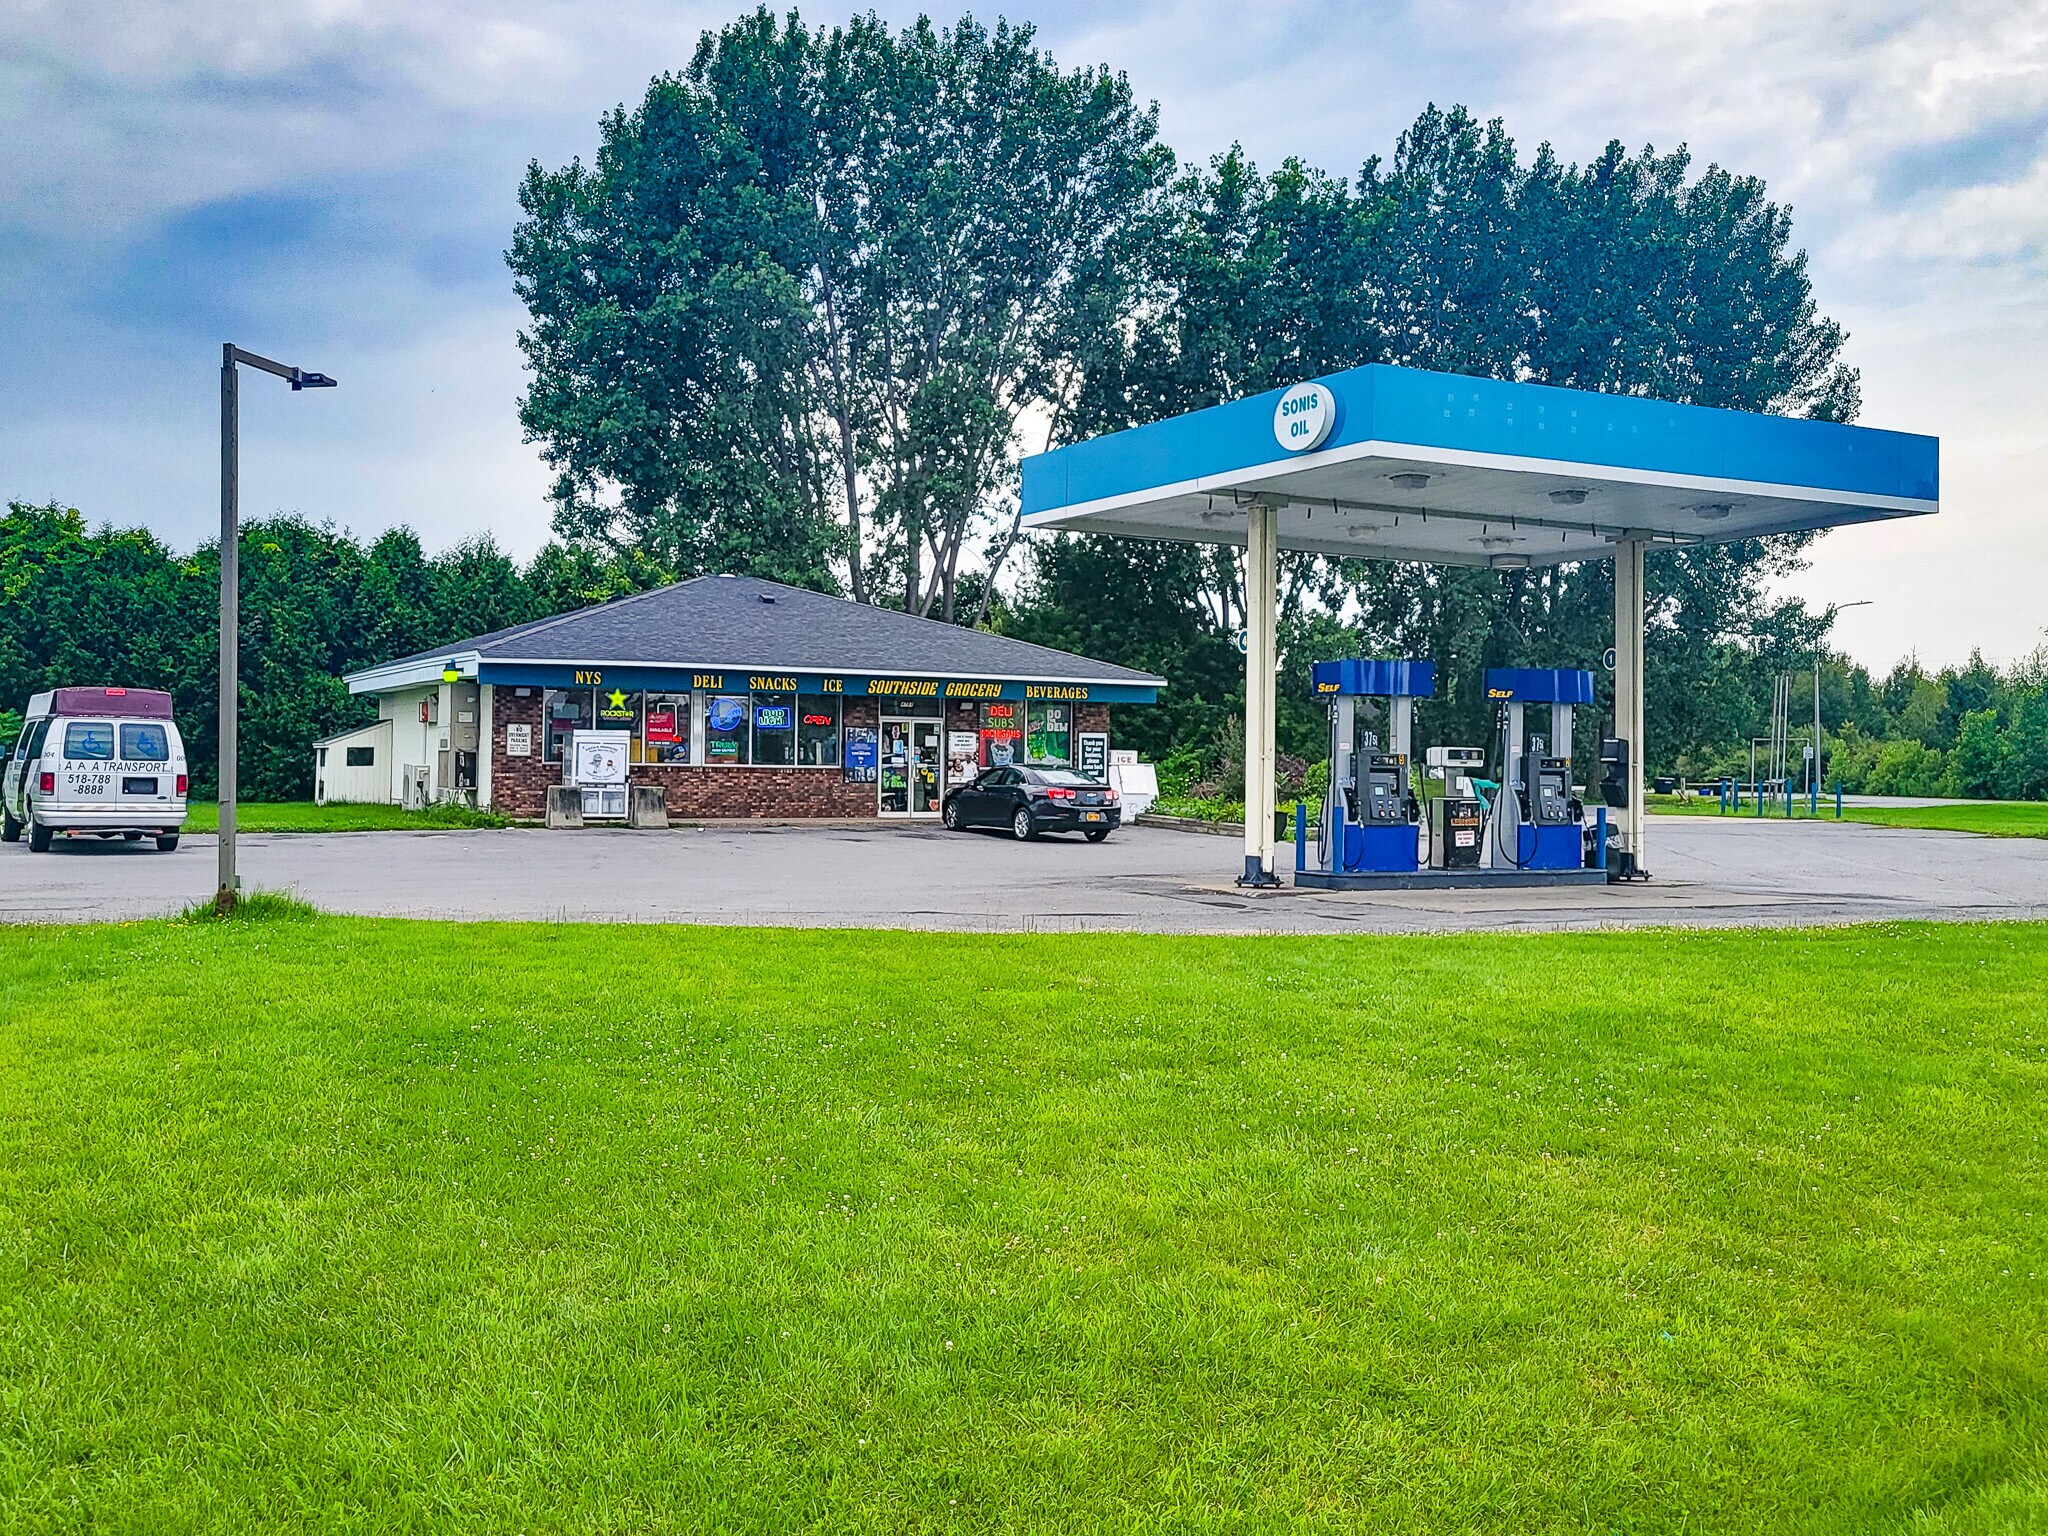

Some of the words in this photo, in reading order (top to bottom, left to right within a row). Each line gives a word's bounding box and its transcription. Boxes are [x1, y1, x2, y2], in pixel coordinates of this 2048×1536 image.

[1282, 393, 1318, 416] SONIS
[1290, 420, 1309, 437] OIL
[575, 671, 602, 685] NYS
[693, 675, 723, 689] DELI
[750, 677, 797, 691] SNACKS
[823, 679, 843, 692] ICE
[867, 679, 939, 696] SOUTHSIDE
[945, 682, 1003, 698] GROCERY
[1026, 685, 1088, 700] BEVERAGES
[762, 708, 785, 718] BUD
[1046, 709, 1062, 720] DO
[803, 714, 831, 726] OPEN
[988, 717, 1015, 728] SUBS
[1046, 719, 1068, 732] DEW
[980, 729, 1021, 739] MICHIGANS
[103, 762, 168, 772] TRANSPORT
[67, 774, 111, 784] 518-788
[73, 785, 104, 795] -8888
